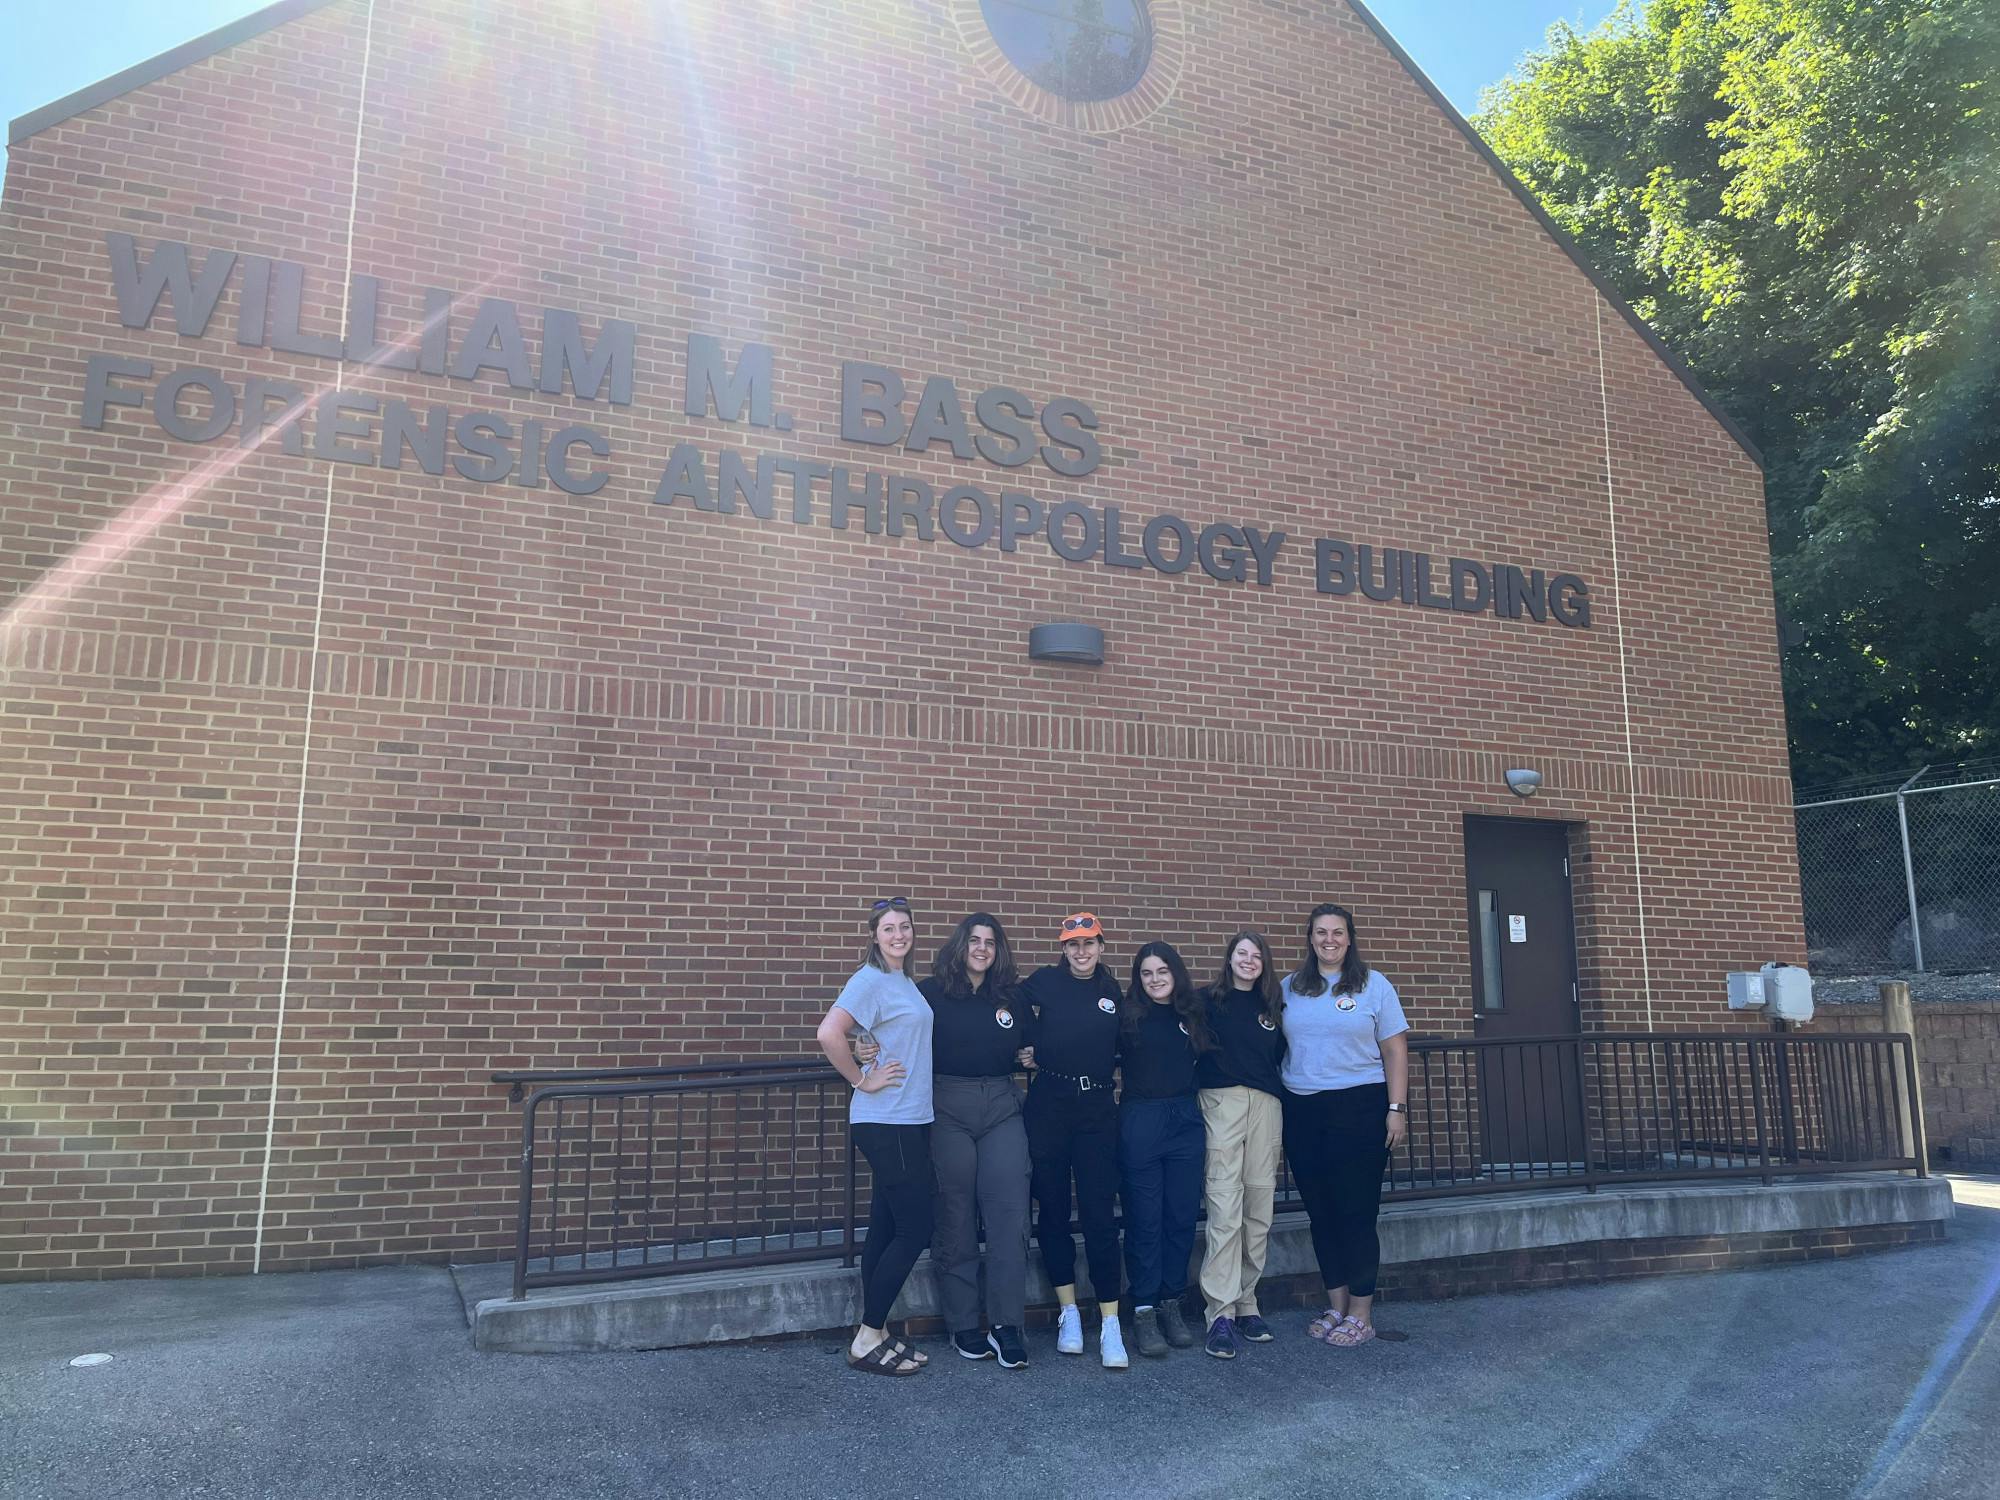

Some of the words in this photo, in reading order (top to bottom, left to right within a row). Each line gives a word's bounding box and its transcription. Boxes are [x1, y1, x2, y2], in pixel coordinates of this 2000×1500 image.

[106, 231, 634, 406] WILLIAM
[685, 333, 793, 432] M.
[841, 361, 1100, 477] BASS
[80, 354, 611, 495] FORENSIC
[653, 443, 1286, 586] ANTHROPOLOGY
[1316, 538, 1591, 628] BUILDING
